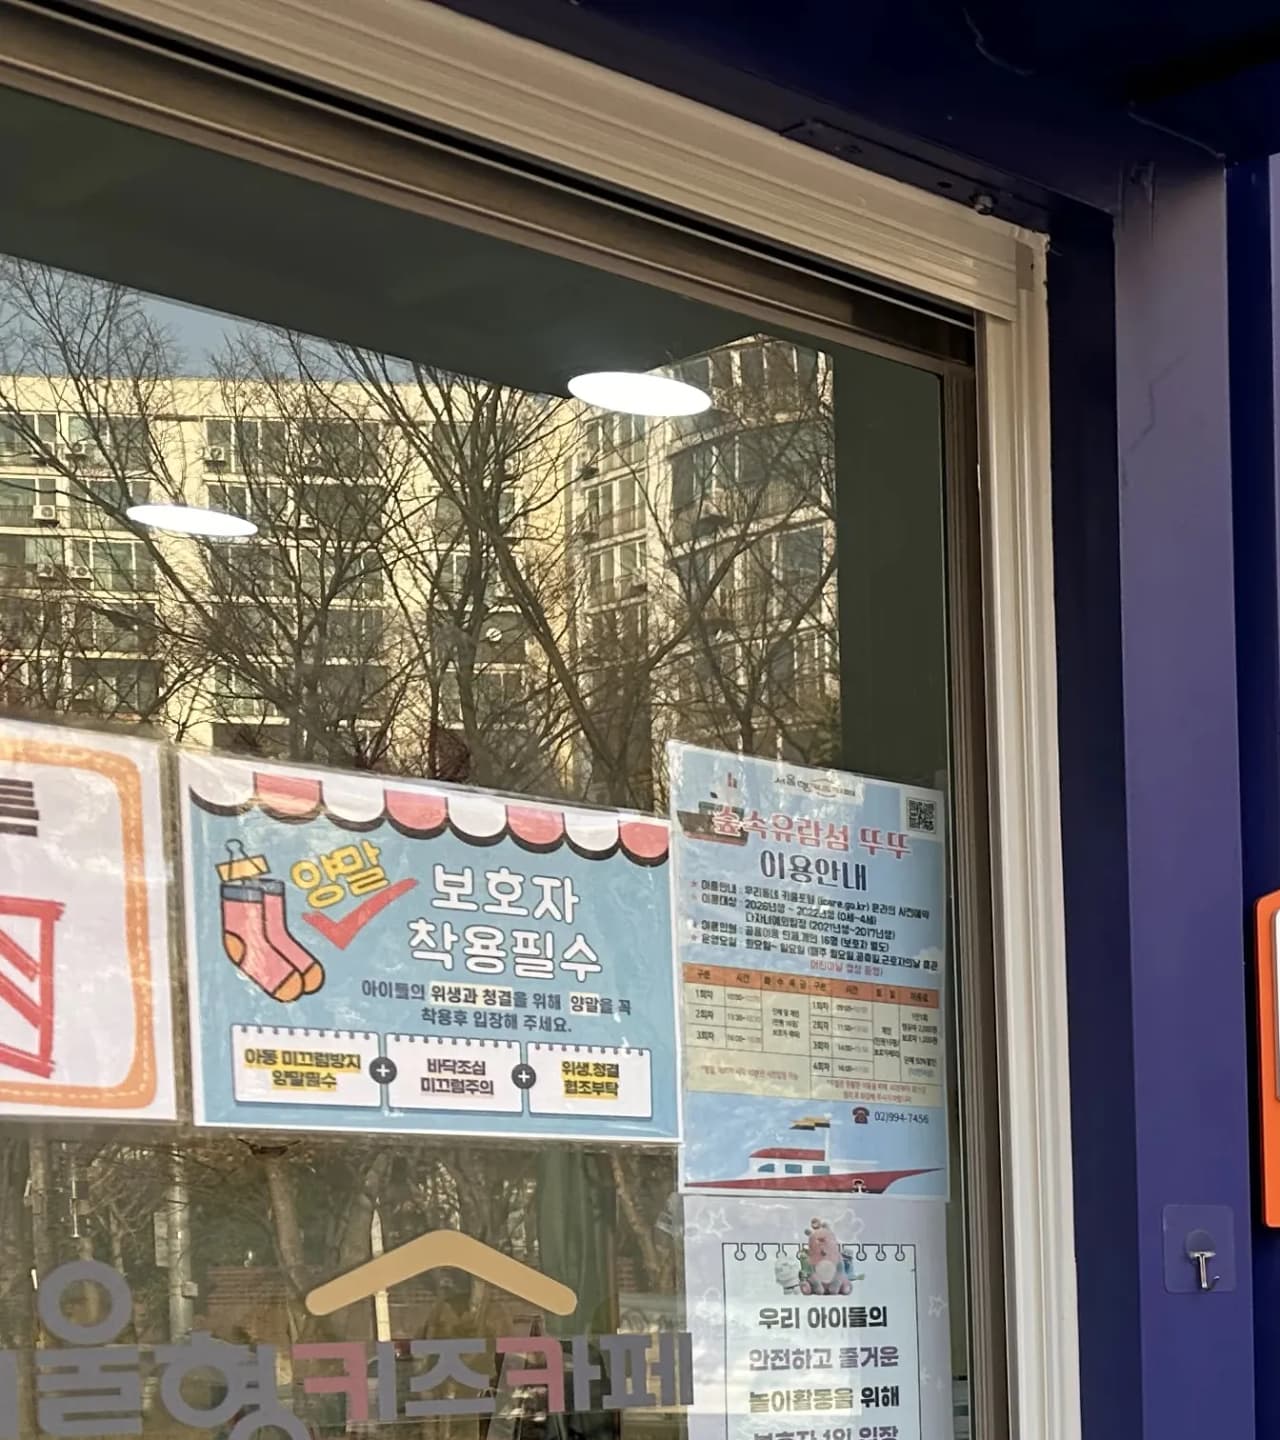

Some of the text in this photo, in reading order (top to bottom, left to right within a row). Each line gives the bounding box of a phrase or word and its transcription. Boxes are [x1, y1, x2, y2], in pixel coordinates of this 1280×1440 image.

[859, 827, 912, 859] 뚜뚜
[290, 839, 390, 909] 양말
[760, 850, 868, 891] 이용안내
[431, 863, 581, 925] 보호자
[407, 917, 603, 983] 착용필수
[361, 979, 425, 1000] 아이들의
[430, 982, 478, 1006] 위생과
[482, 986, 527, 1009] 청결을
[532, 992, 561, 1010] 위해
[570, 994, 613, 1015] 양말을
[421, 1006, 572, 1033] 착용후 입장해 주세요.
[282, 1050, 361, 1069] 미끄럼방지
[426, 1058, 486, 1076] 바닥조심
[420, 1077, 494, 1096] 미끄럼주의
[758, 1306, 888, 1329] 우리 아이들의
[749, 1346, 899, 1371] 안전하고 즐거운
[749, 1385, 900, 1413] 놀이활동을 위해
